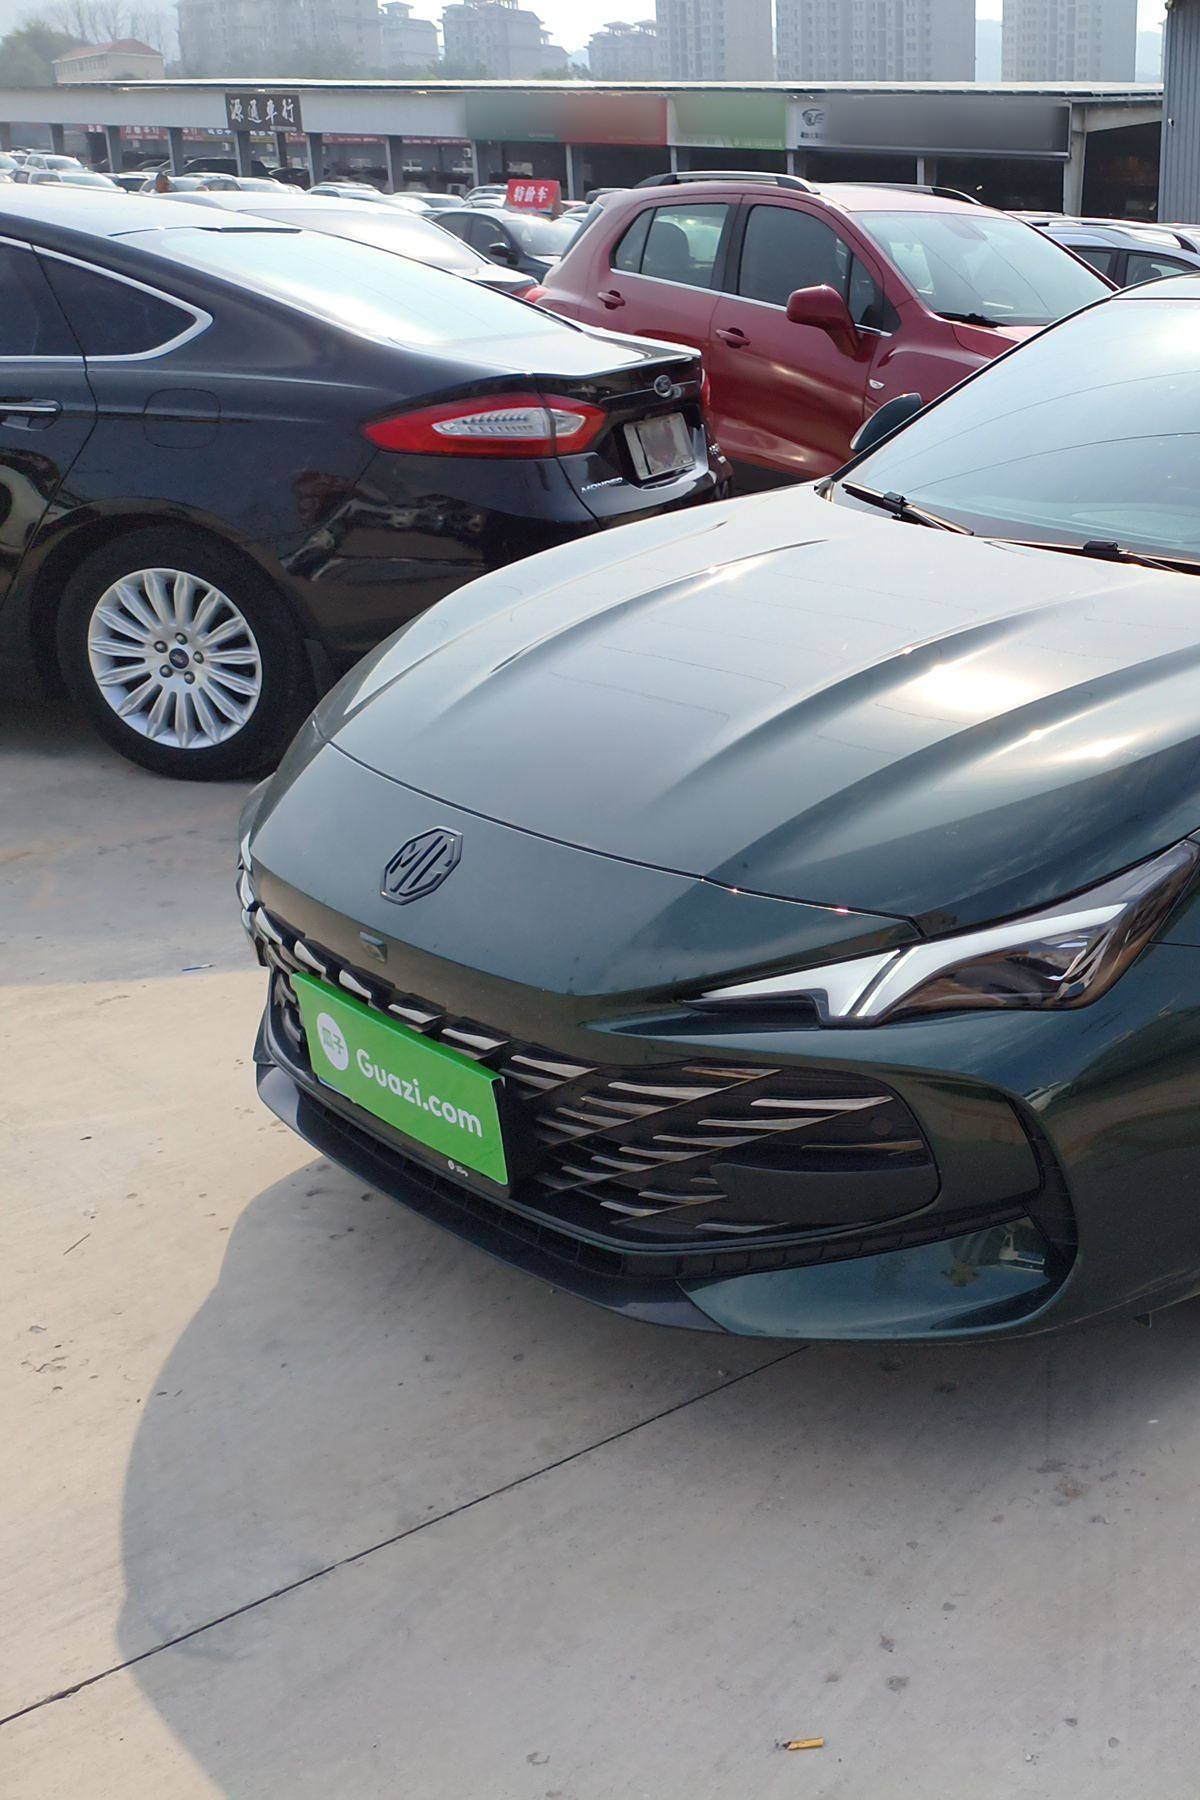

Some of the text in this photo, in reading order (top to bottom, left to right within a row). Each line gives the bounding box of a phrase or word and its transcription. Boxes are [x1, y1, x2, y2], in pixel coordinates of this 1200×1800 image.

[513, 185, 549, 203] 特价车
[387, 833, 456, 898] MG
[355, 1048, 484, 1138] Guazi.com
